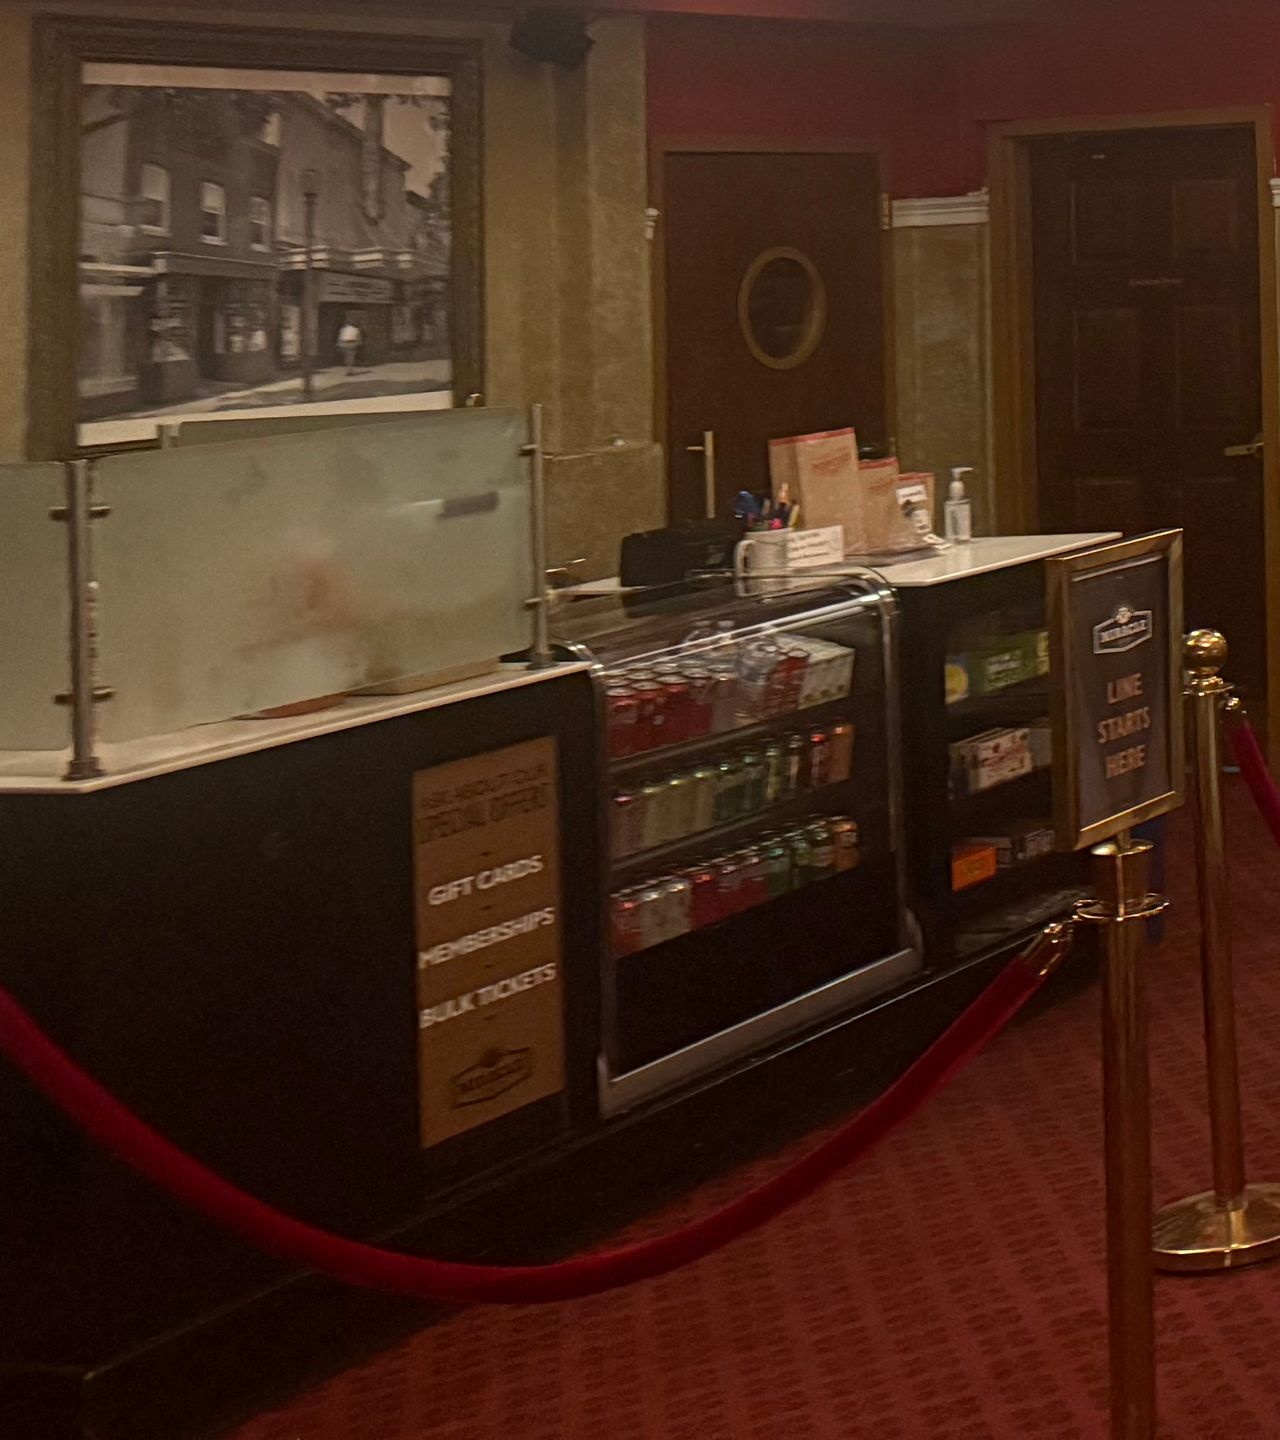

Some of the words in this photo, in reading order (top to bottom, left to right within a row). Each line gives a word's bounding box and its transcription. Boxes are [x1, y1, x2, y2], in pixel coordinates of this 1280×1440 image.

[1105, 744, 1146, 779] HERE
[428, 876, 475, 906] GIFT
[476, 855, 544, 890] CARDS
[418, 907, 556, 970] MEMBERSHIPS
[419, 992, 477, 1029] BULK
[476, 962, 557, 1007] TICKETS
